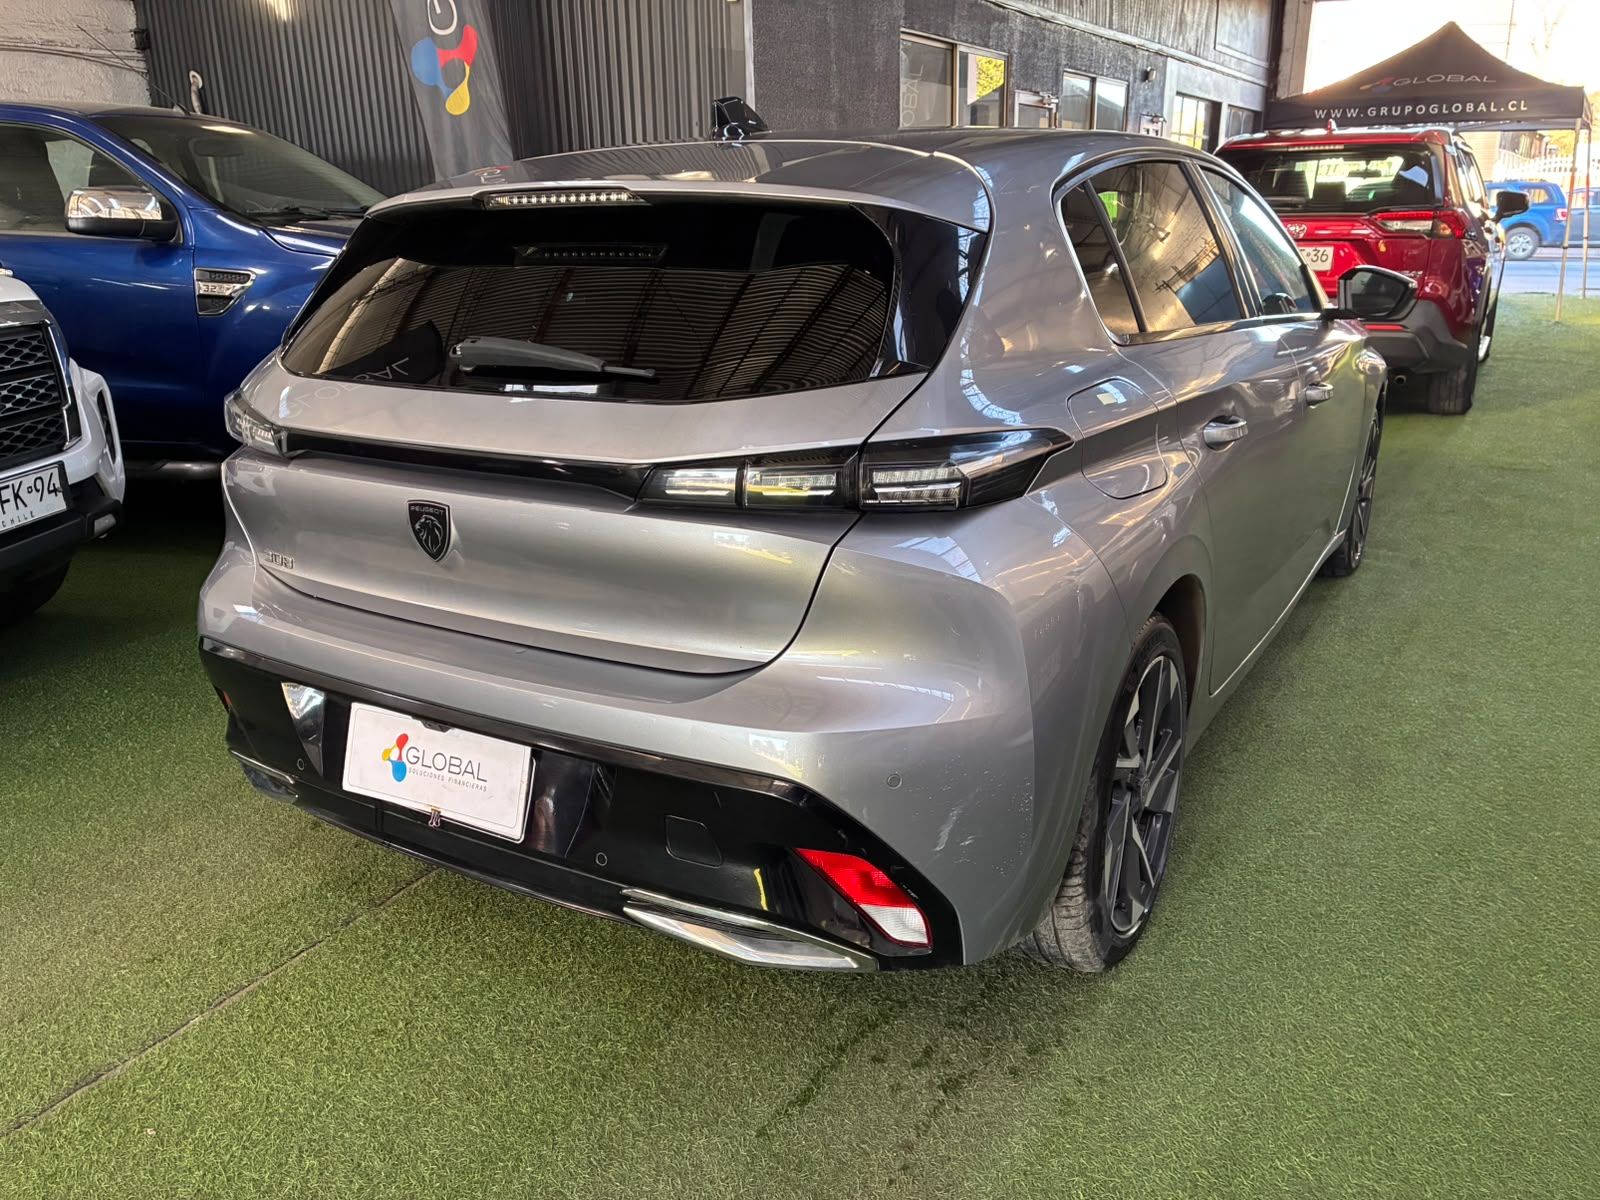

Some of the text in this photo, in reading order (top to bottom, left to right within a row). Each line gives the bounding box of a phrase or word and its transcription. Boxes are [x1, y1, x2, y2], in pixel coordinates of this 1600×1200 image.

[1393, 74, 1497, 87] GLOBAL
[1314, 99, 1529, 119] WWW.GRUPOGLOBAL.CL
[410, 505, 445, 516] PEUGEOT
[406, 746, 488, 782] GLOBAL
[408, 767, 488, 792] SOLUCIONES FINANCIERAS
